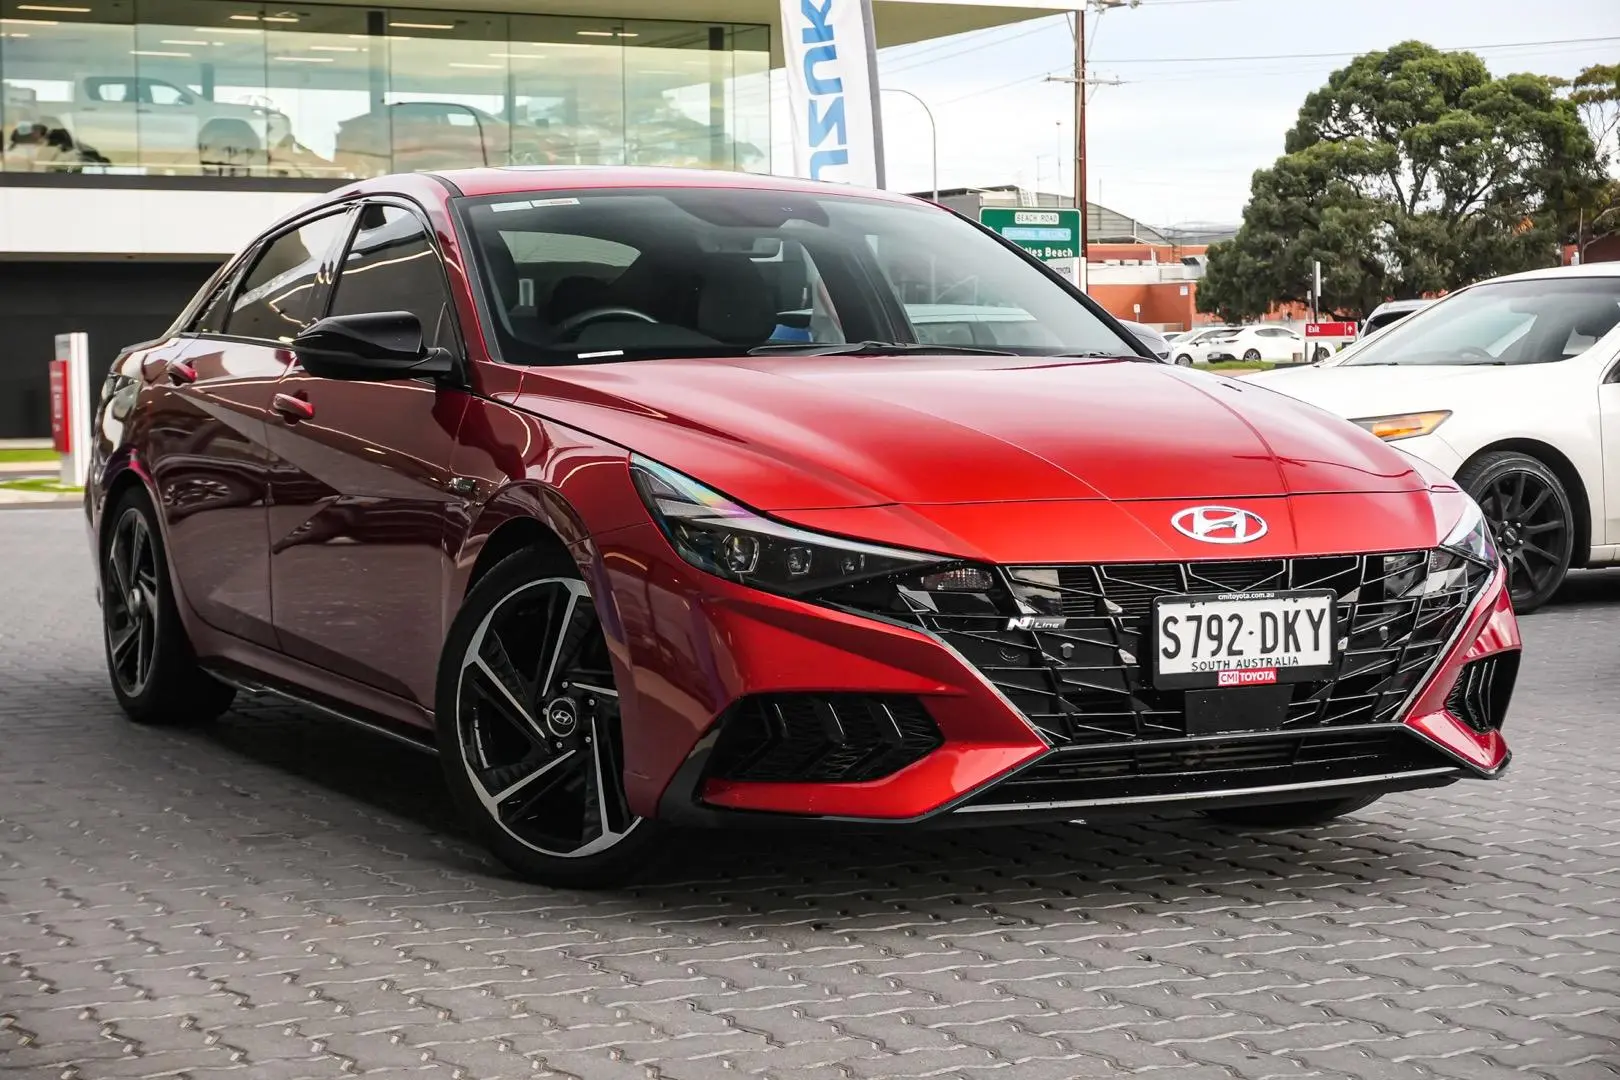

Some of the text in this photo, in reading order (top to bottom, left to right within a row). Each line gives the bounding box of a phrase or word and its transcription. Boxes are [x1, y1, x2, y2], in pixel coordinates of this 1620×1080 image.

[1016, 214, 1057, 223] BEACH ROAD
[1045, 247, 1073, 257] Beach
[1307, 325, 1320, 333] Exit
[1218, 592, 1275, 600] cmitoyota.com.au
[1191, 656, 1299, 672] SOUTH AUSTRALIA
[1239, 671, 1276, 682] TOYOTA
